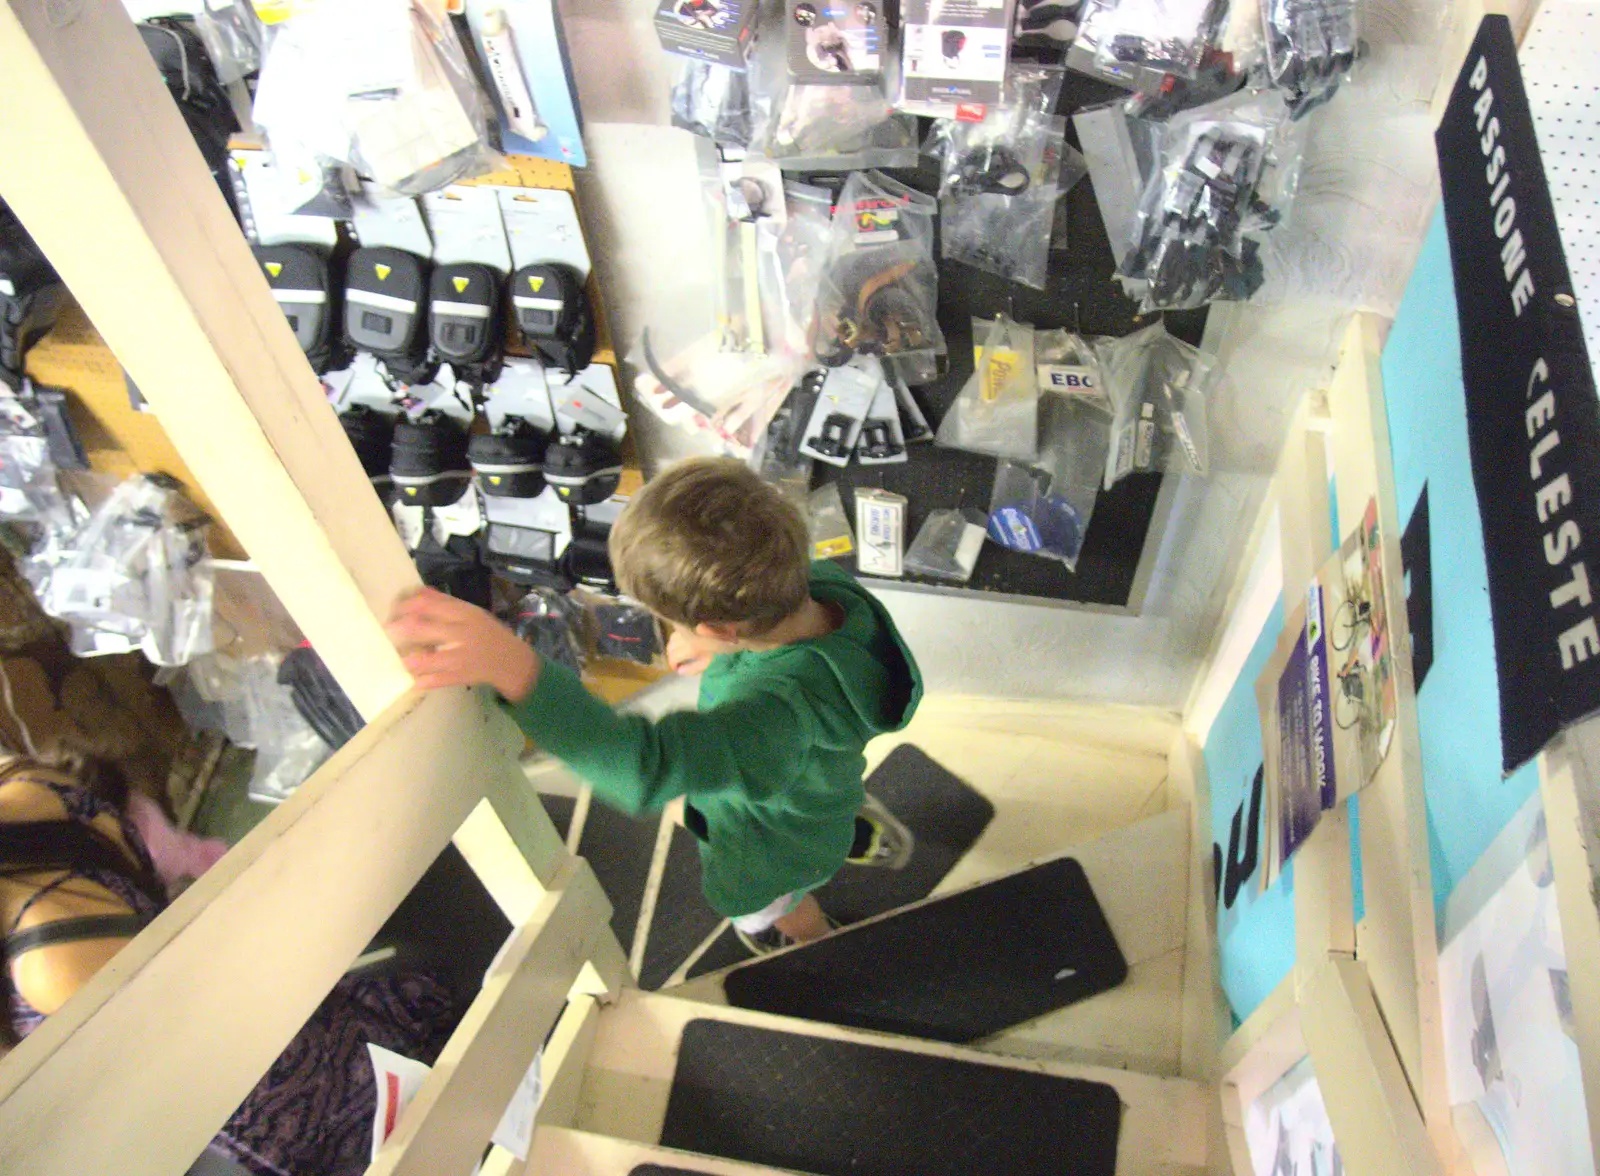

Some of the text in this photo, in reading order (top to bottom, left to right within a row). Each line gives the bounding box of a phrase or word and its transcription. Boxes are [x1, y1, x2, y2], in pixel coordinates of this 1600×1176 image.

[1468, 55, 1600, 670] PASSIONE CELESTE
[1312, 698, 1323, 727] TO
[1312, 727, 1327, 787] WORK
